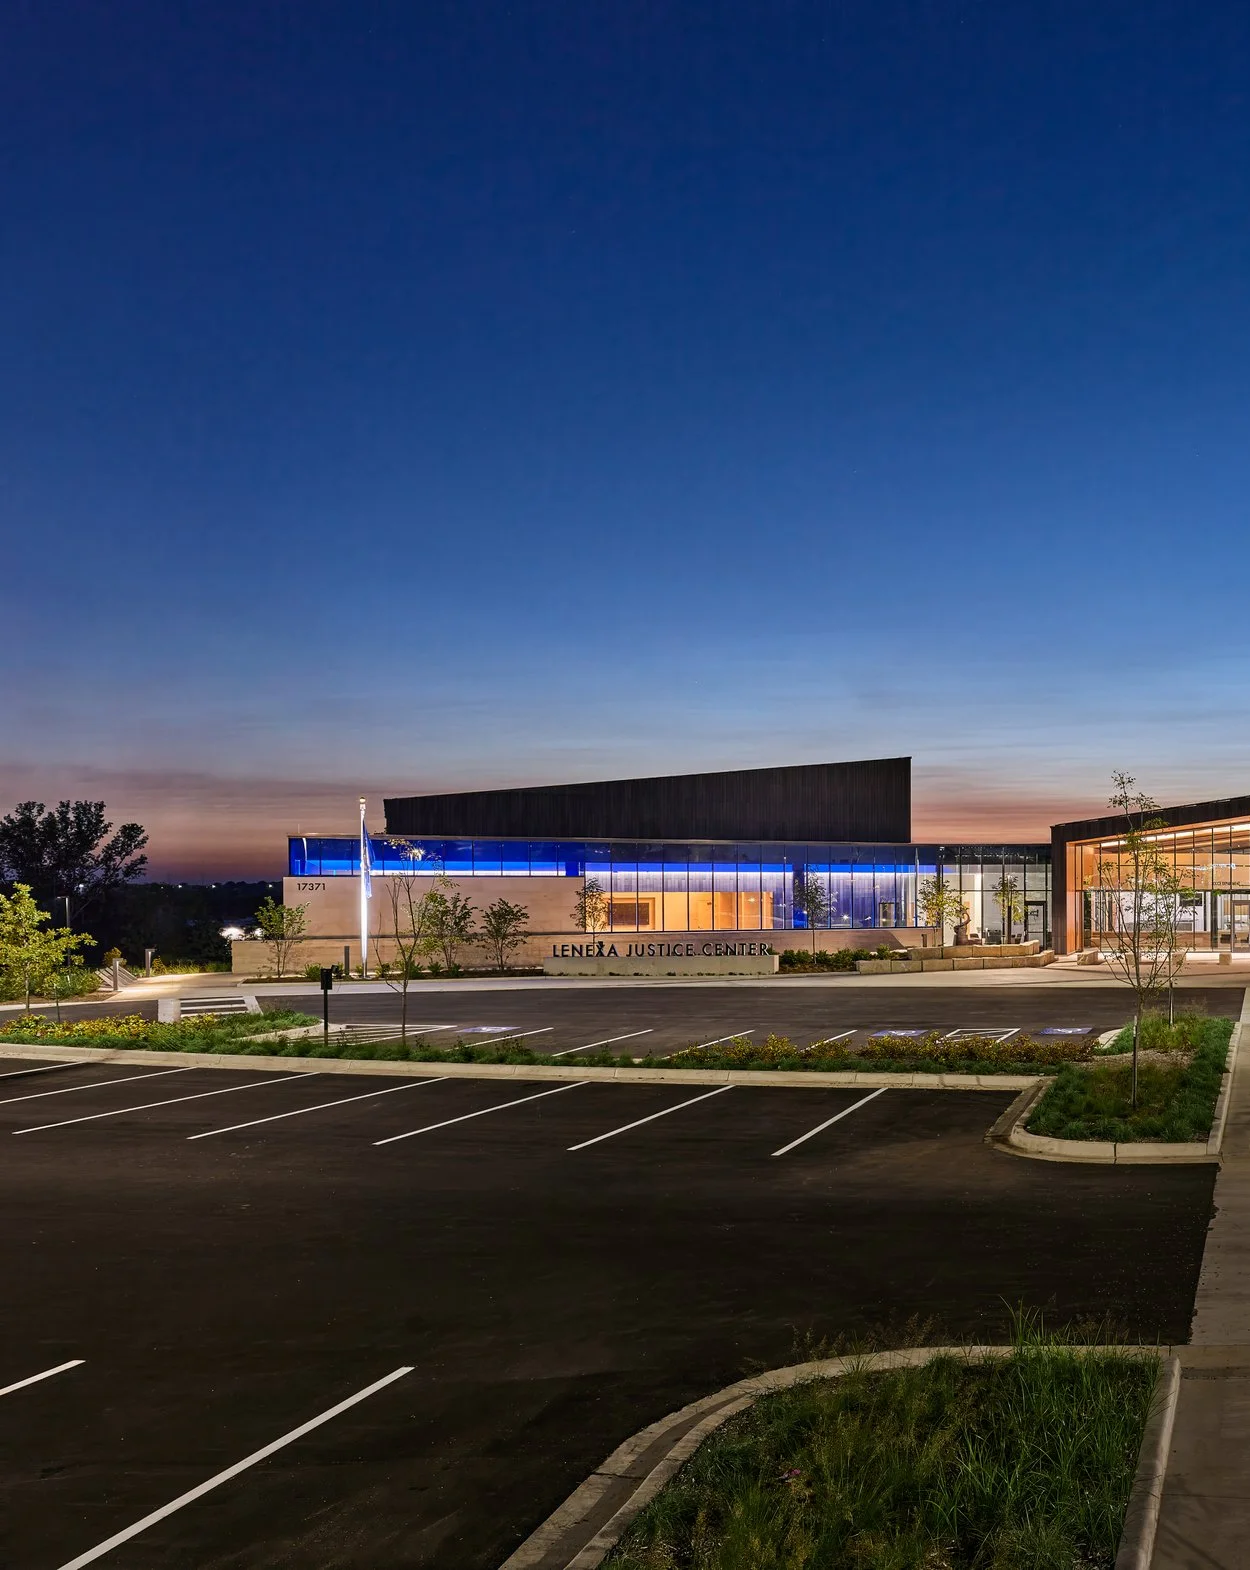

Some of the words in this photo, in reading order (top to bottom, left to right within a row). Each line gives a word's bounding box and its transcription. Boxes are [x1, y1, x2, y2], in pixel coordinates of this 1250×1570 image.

[297, 882, 326, 891] 17371
[553, 943, 619, 957] LENEXA
[626, 943, 694, 957] JUSTICE
[702, 942, 770, 956] CENTER
